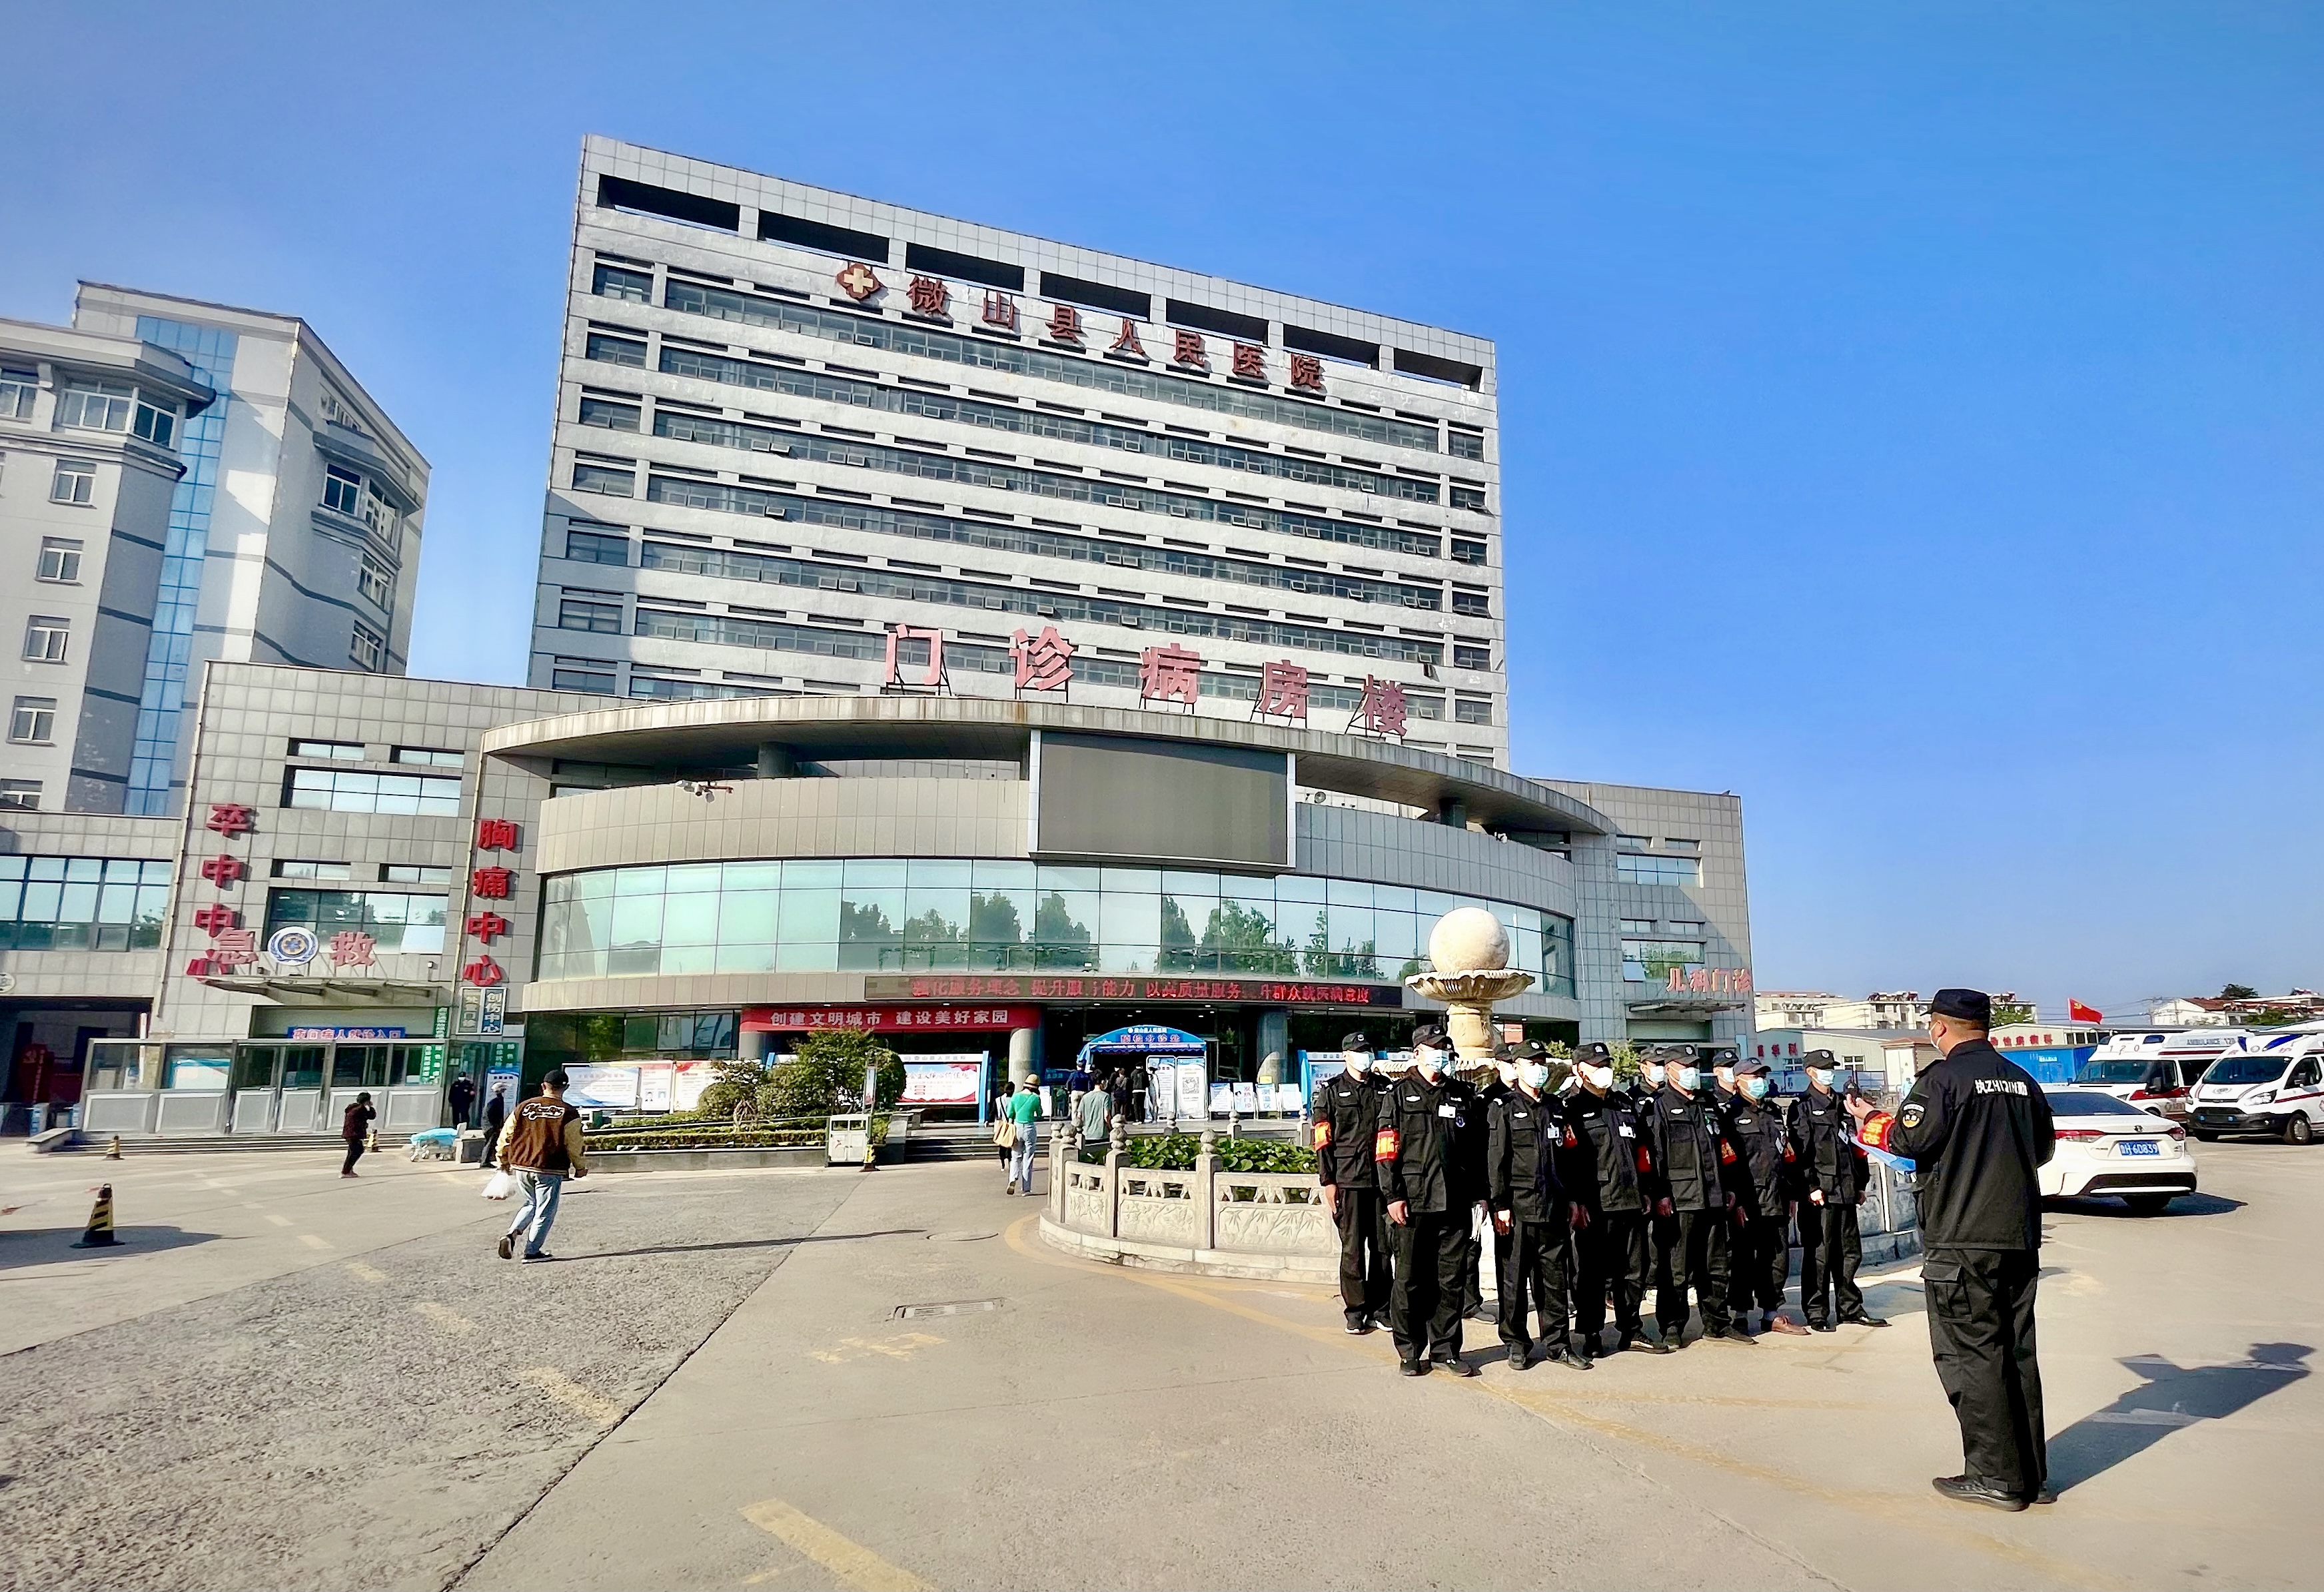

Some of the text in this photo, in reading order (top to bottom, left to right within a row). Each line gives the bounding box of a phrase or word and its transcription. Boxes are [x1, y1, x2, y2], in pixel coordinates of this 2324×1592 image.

[906, 274, 1323, 389] 微山县人民医院
[885, 624, 1408, 737] 门诊病房楼
[463, 819, 517, 987] 胸痛中心
[1666, 967, 1752, 993] 儿科门诊
[483, 993, 502, 1032] 创伤中心
[770, 1010, 1009, 1026] 创建文明城市 建设美好家园
[2109, 1044, 2140, 1055] 120
